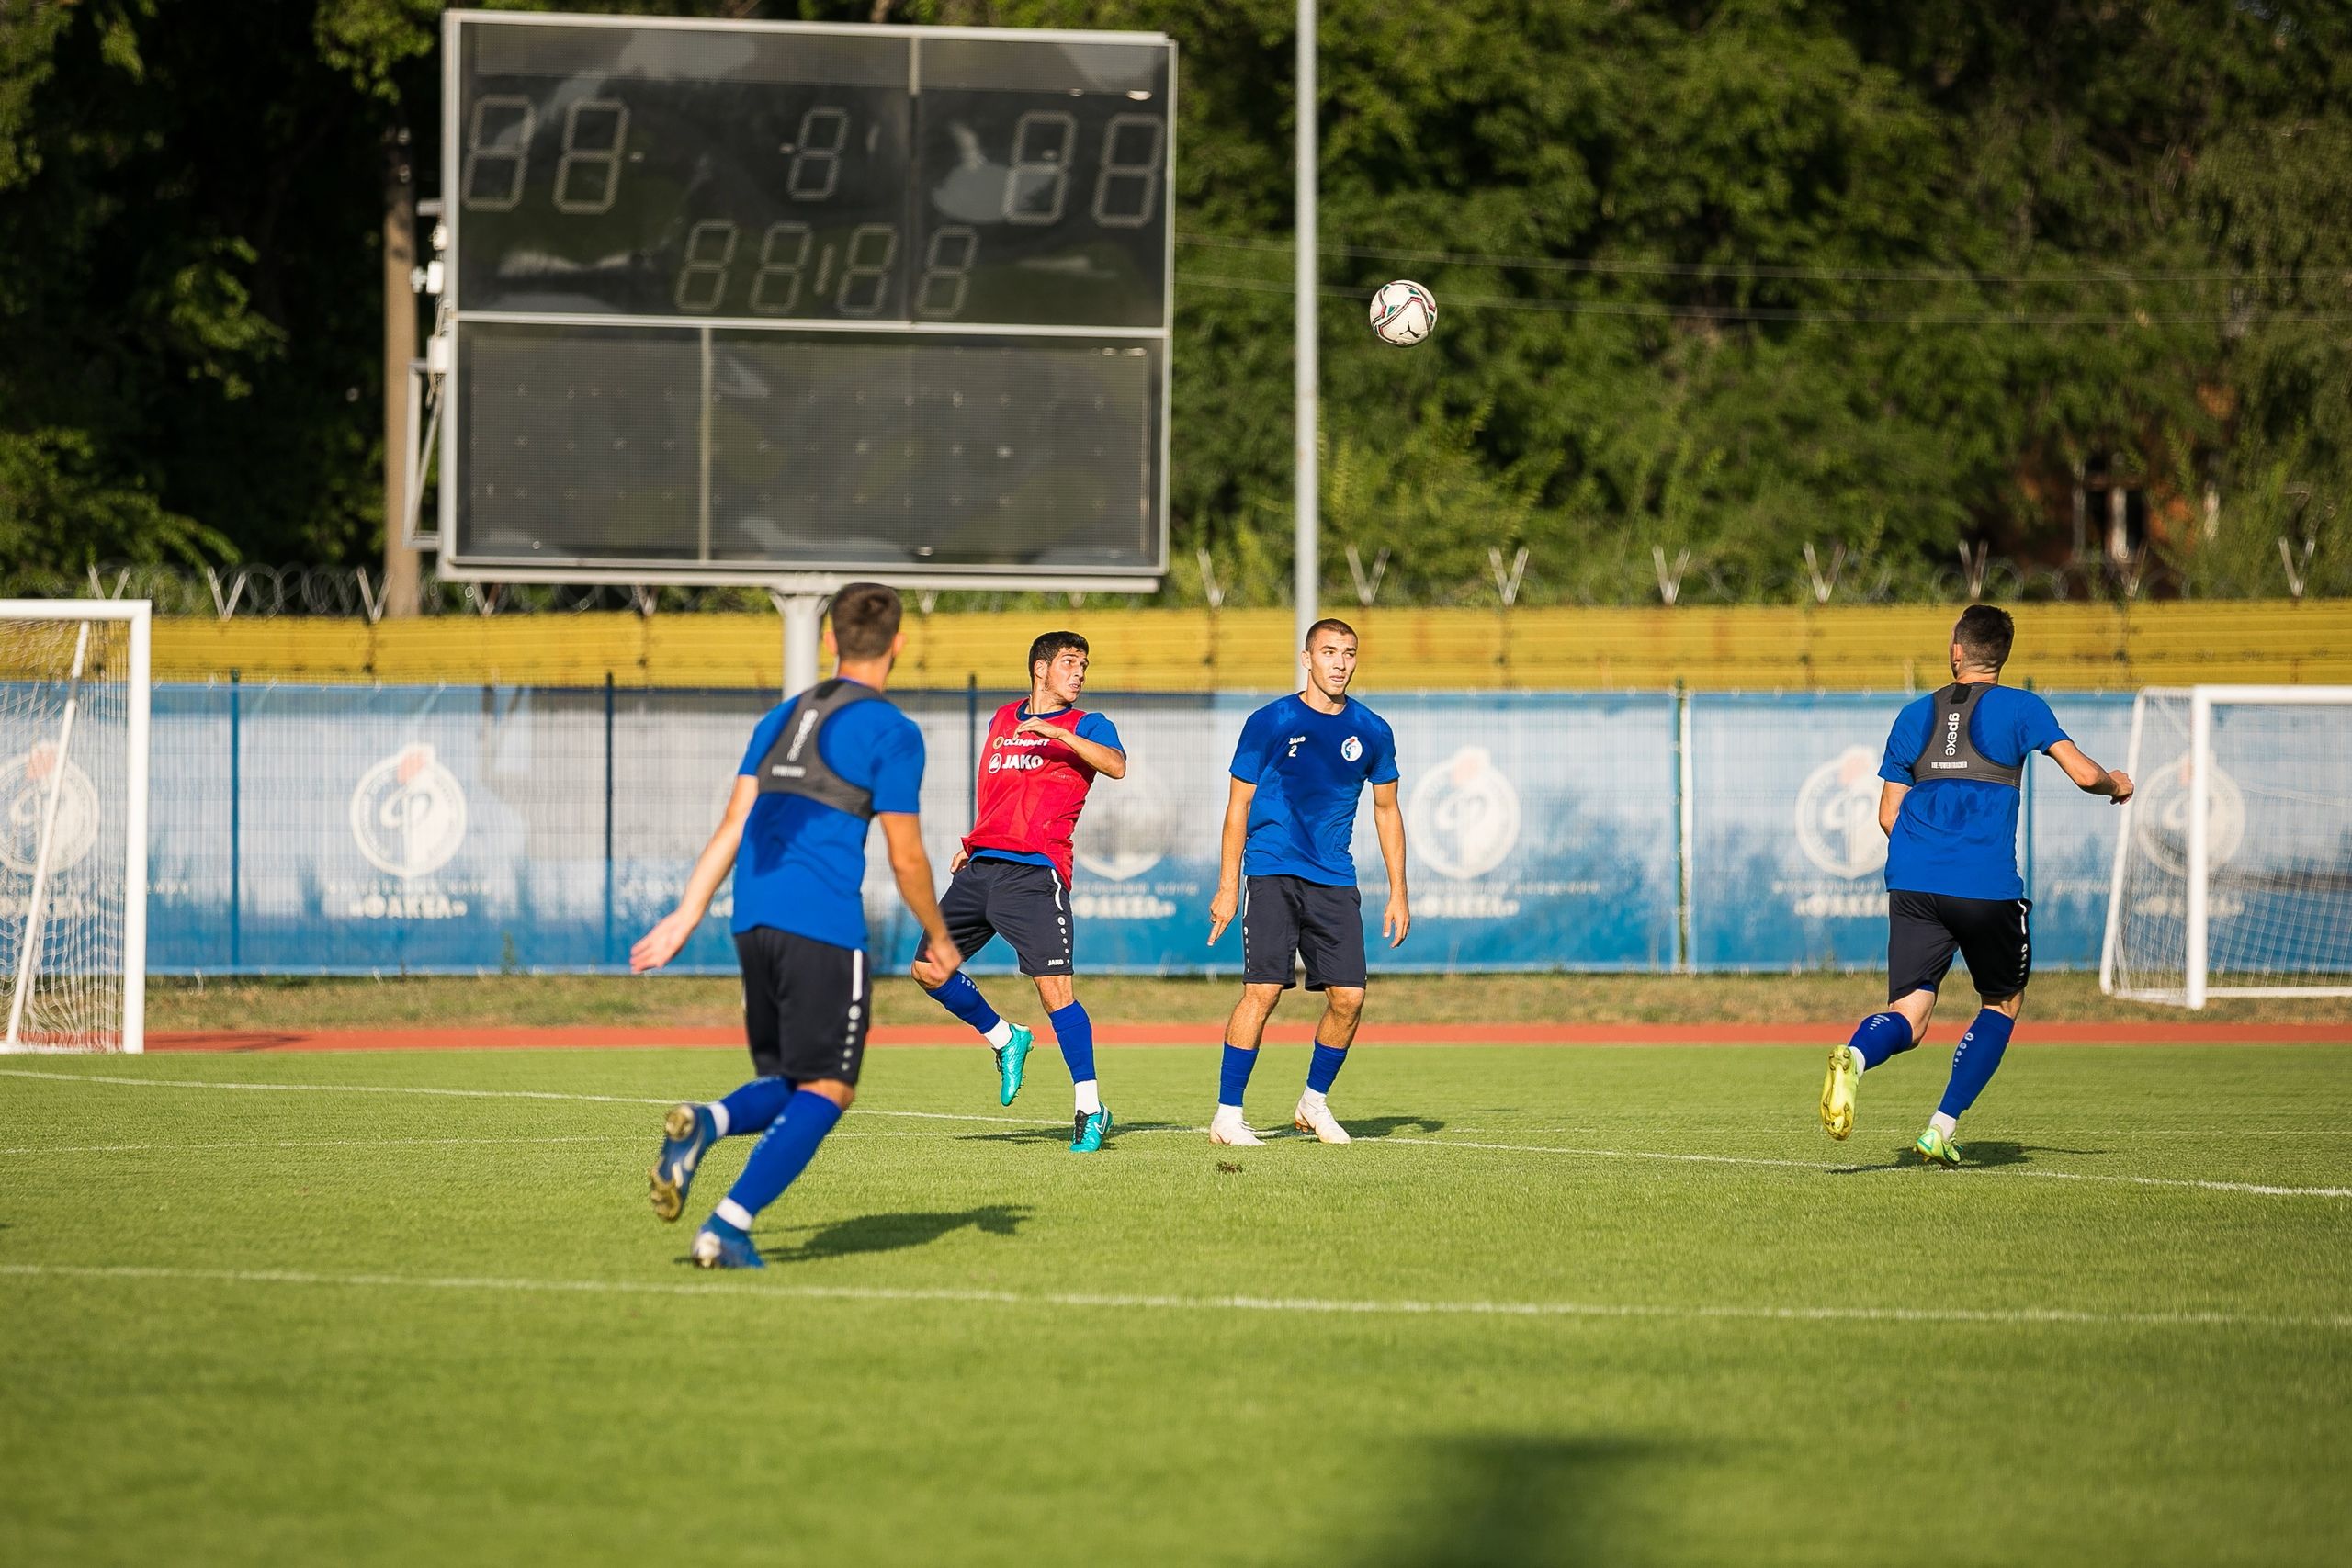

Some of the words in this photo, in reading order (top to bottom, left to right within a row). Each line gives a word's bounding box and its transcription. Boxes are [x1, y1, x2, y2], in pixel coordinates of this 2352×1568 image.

[1945, 712, 1960, 756] gpexe
[1288, 744, 1297, 758] 2
[1001, 754, 1044, 770] JAKO
